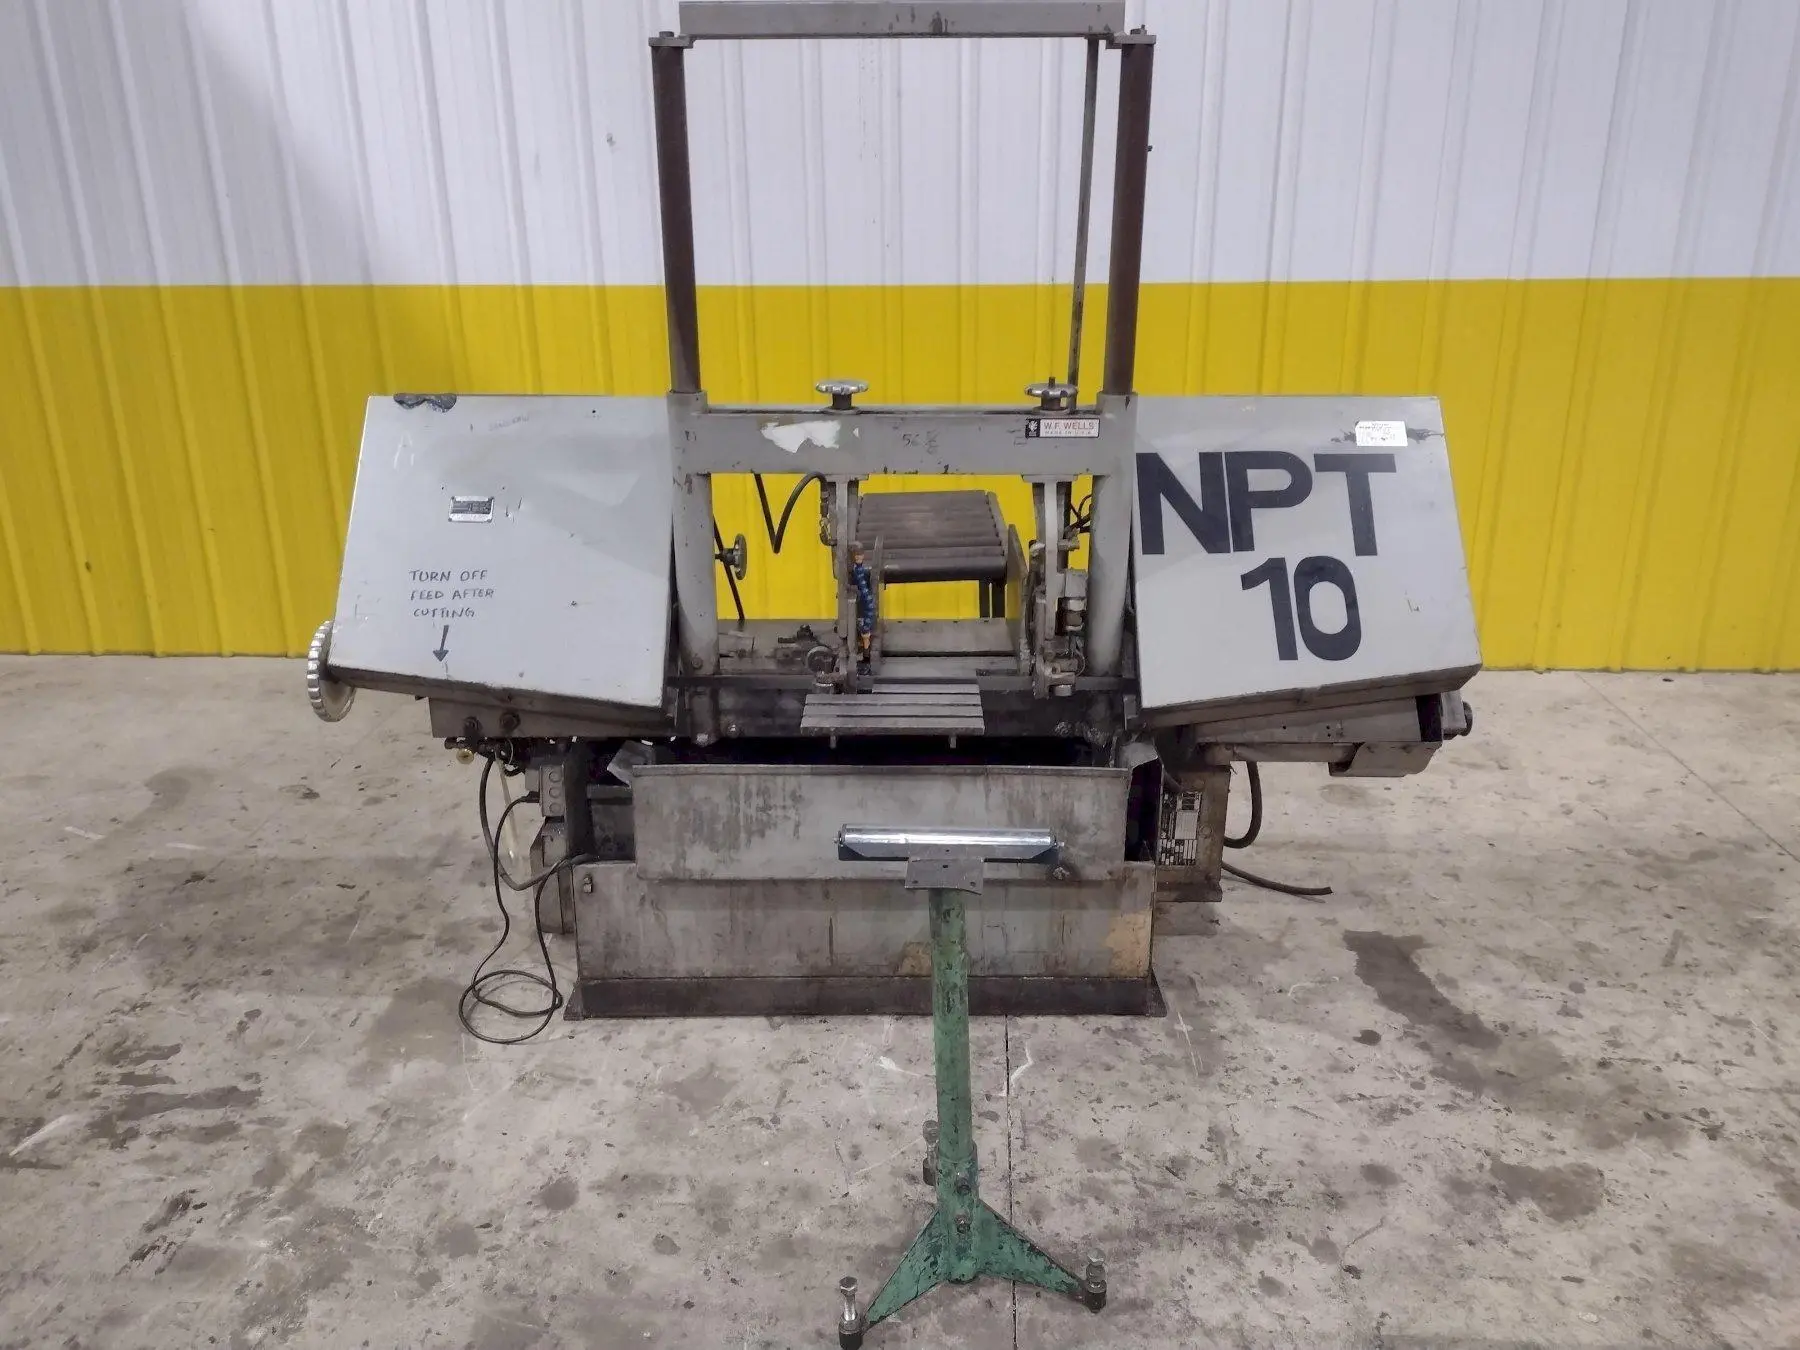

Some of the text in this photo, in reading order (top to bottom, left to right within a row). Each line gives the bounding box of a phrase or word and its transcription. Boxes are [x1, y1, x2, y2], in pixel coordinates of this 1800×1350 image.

[1063, 421, 1095, 430] WELLS
[1136, 451, 1396, 556] NPT
[409, 569, 488, 582] TURN OFF
[410, 588, 494, 601] FEED AFTER
[413, 607, 475, 619] CUTTING
[1240, 556, 1361, 661] 10
